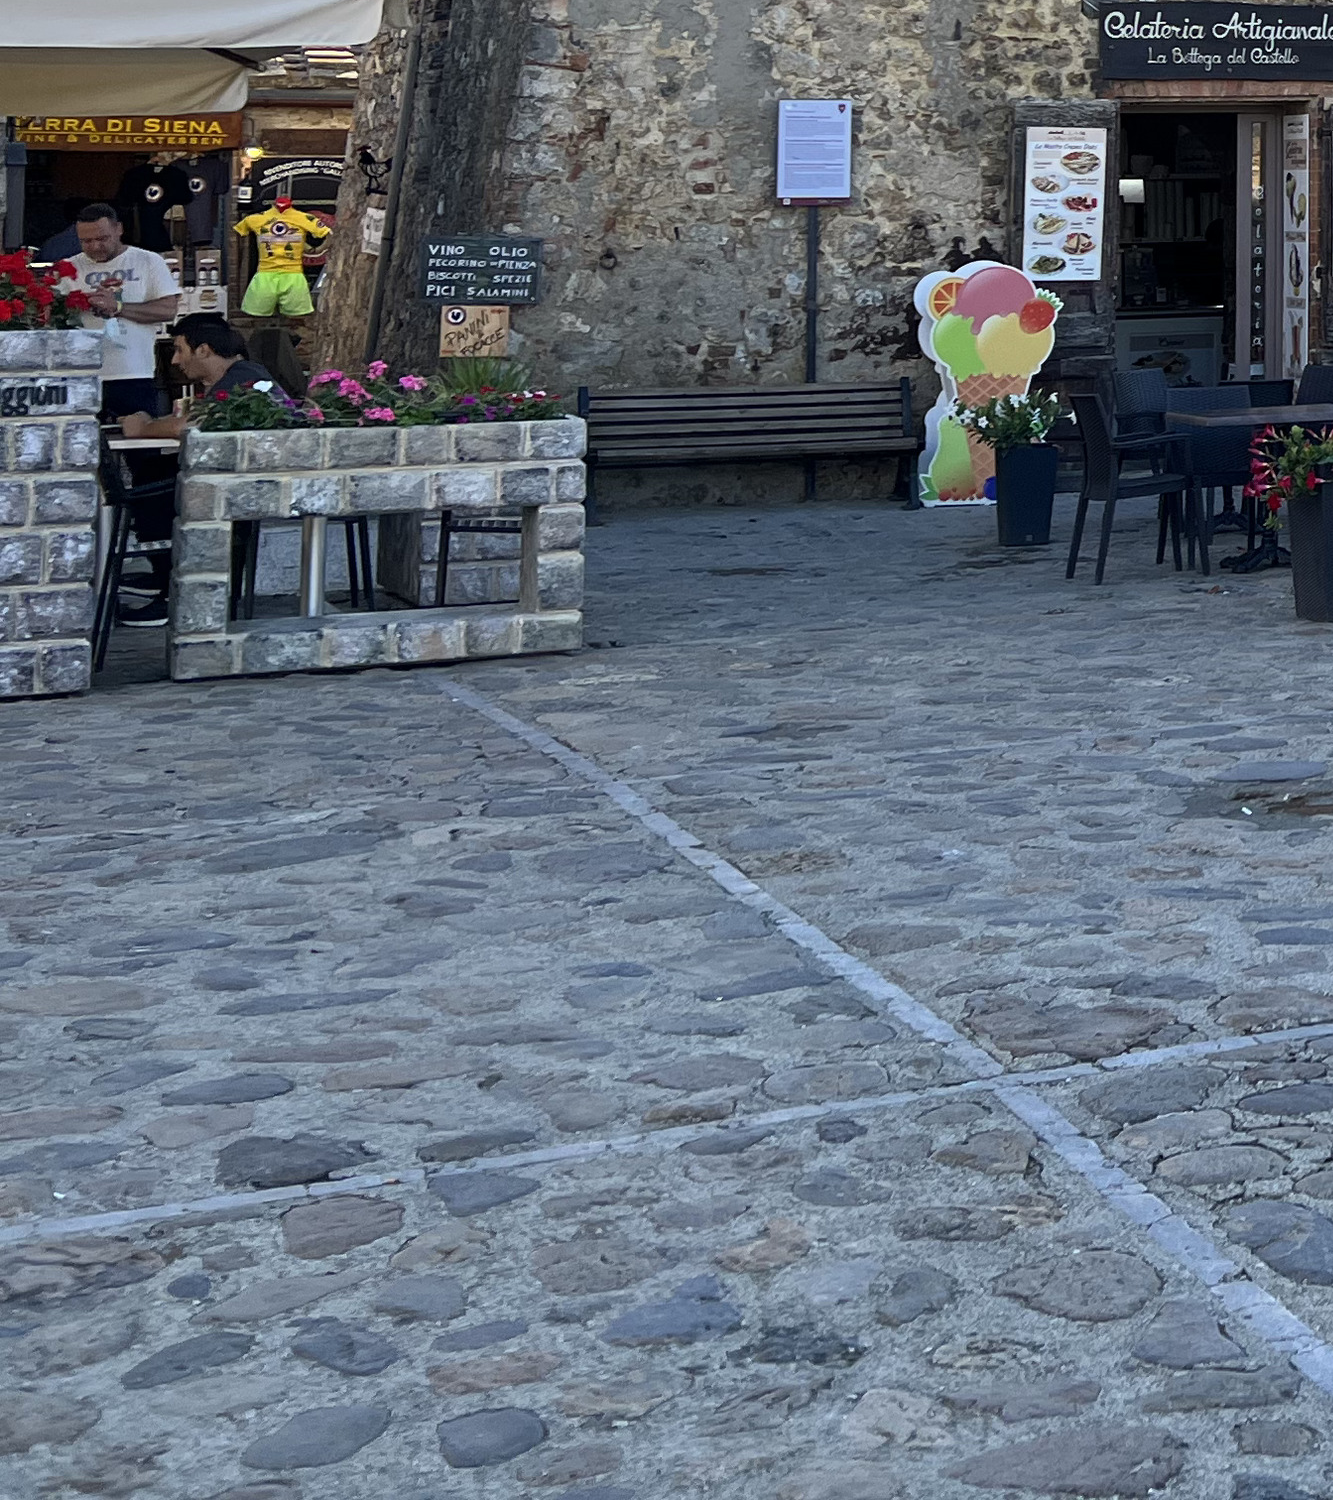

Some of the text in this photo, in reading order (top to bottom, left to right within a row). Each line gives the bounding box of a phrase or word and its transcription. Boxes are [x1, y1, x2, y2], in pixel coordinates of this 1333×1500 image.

[1103, 10, 1206, 40] Gelateria
[1147, 47, 1300, 72] La Bottega del Castello
[106, 119, 131, 132] DI
[144, 118, 223, 134] SIENA
[428, 244, 528, 257] VINO OLIO
[428, 258, 487, 268] PECORINO
[492, 274, 532, 283] SPEZIE
[426, 284, 529, 297] PICI SALAMINI
[444, 309, 490, 348] PANINI
